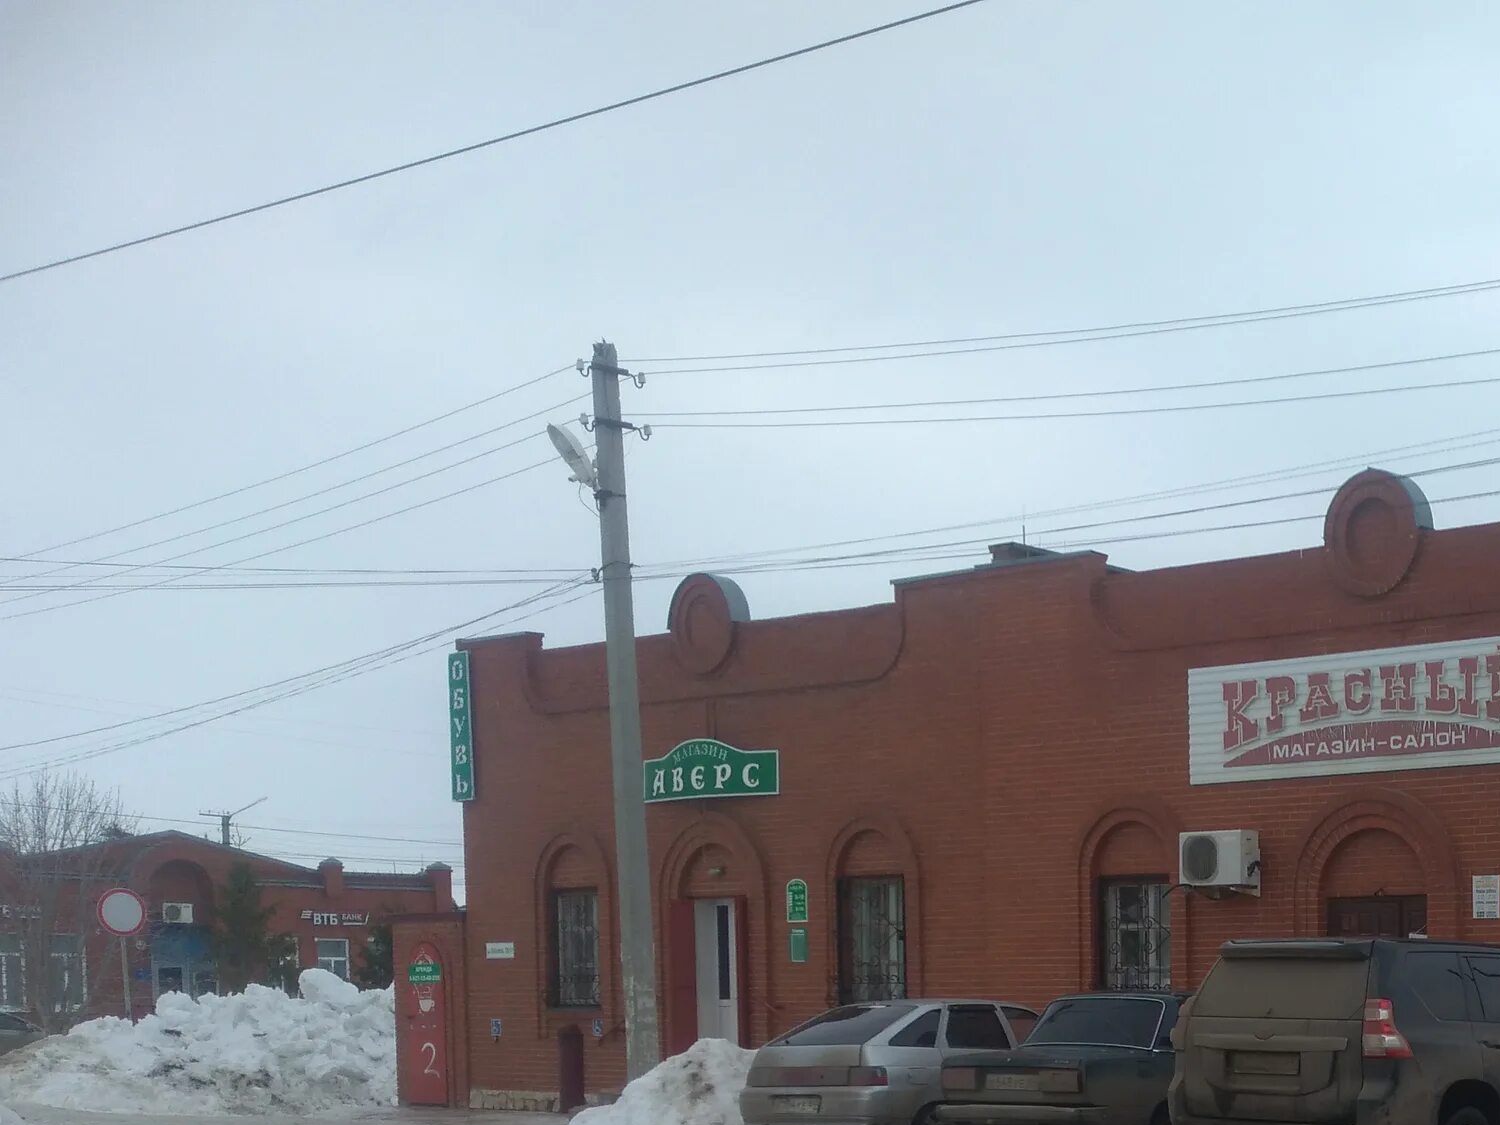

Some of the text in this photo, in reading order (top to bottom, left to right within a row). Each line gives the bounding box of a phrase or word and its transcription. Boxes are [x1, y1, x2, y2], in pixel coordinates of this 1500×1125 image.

[452, 660, 468, 793] ОБУВЬ
[673, 744, 728, 764] МАГАЗИН
[1273, 731, 1466, 759] МАГАЗИН-САЛОН
[653, 763, 760, 796] АВЕРС
[313, 913, 338, 925] ВТБ
[421, 1042, 440, 1078] 2
